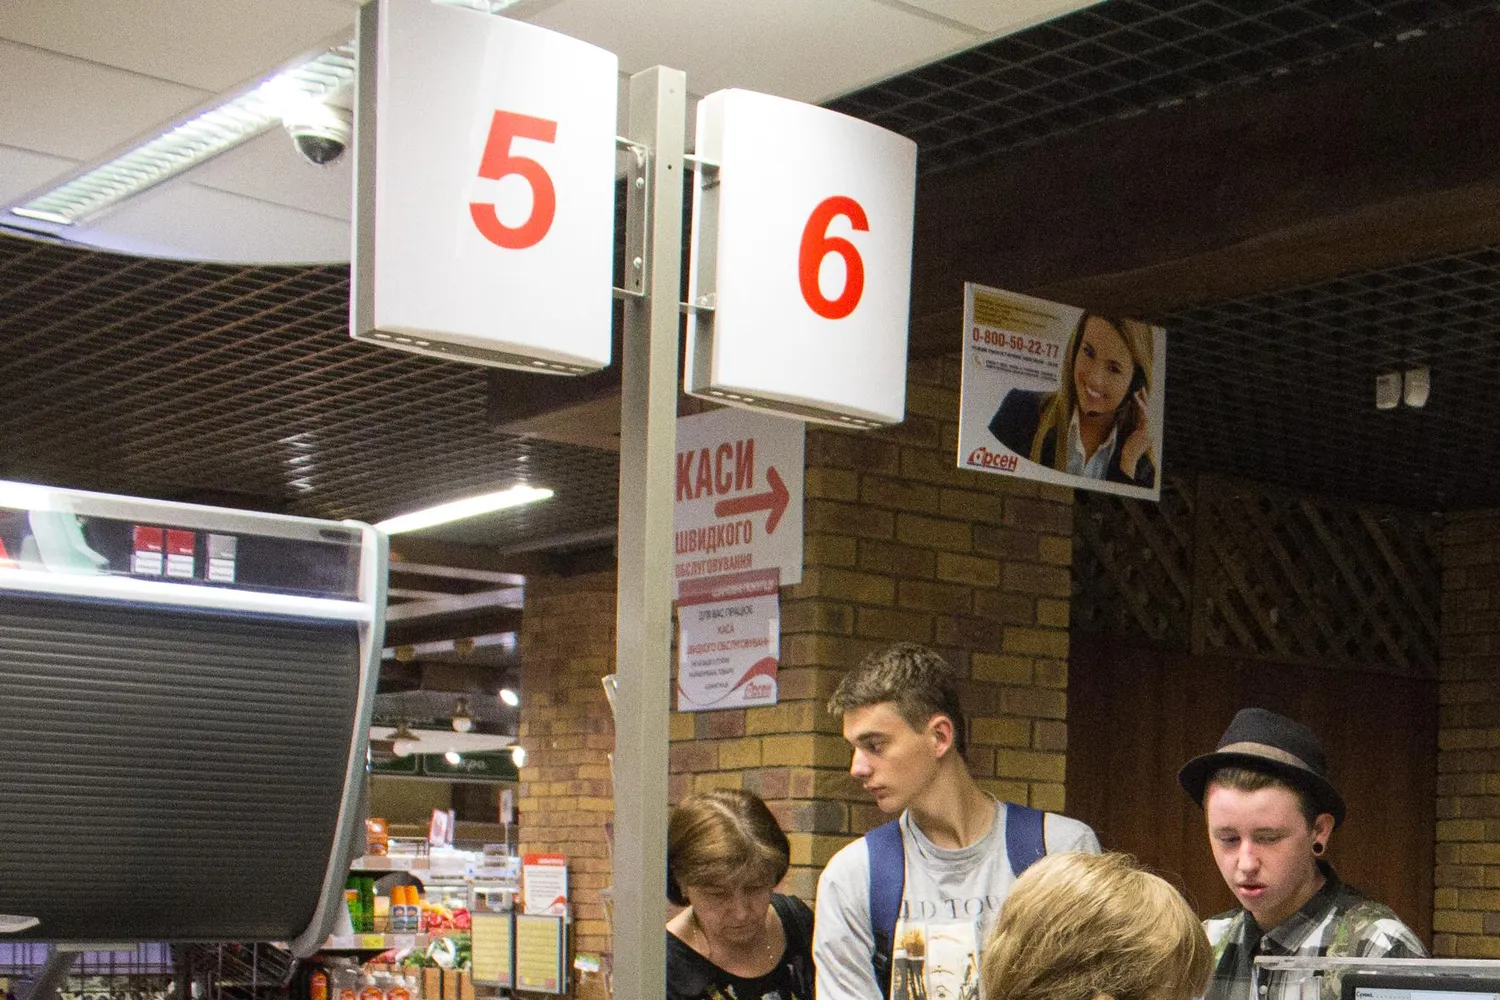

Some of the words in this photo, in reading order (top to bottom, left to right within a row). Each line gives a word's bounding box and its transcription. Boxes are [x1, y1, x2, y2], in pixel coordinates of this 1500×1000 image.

[469, 109, 558, 250] 5
[799, 195, 870, 320] 6
[972, 327, 1060, 358] 0-800-50-22-77
[676, 438, 754, 502] КАСИ
[676, 520, 753, 556] ШВИДКОГО
